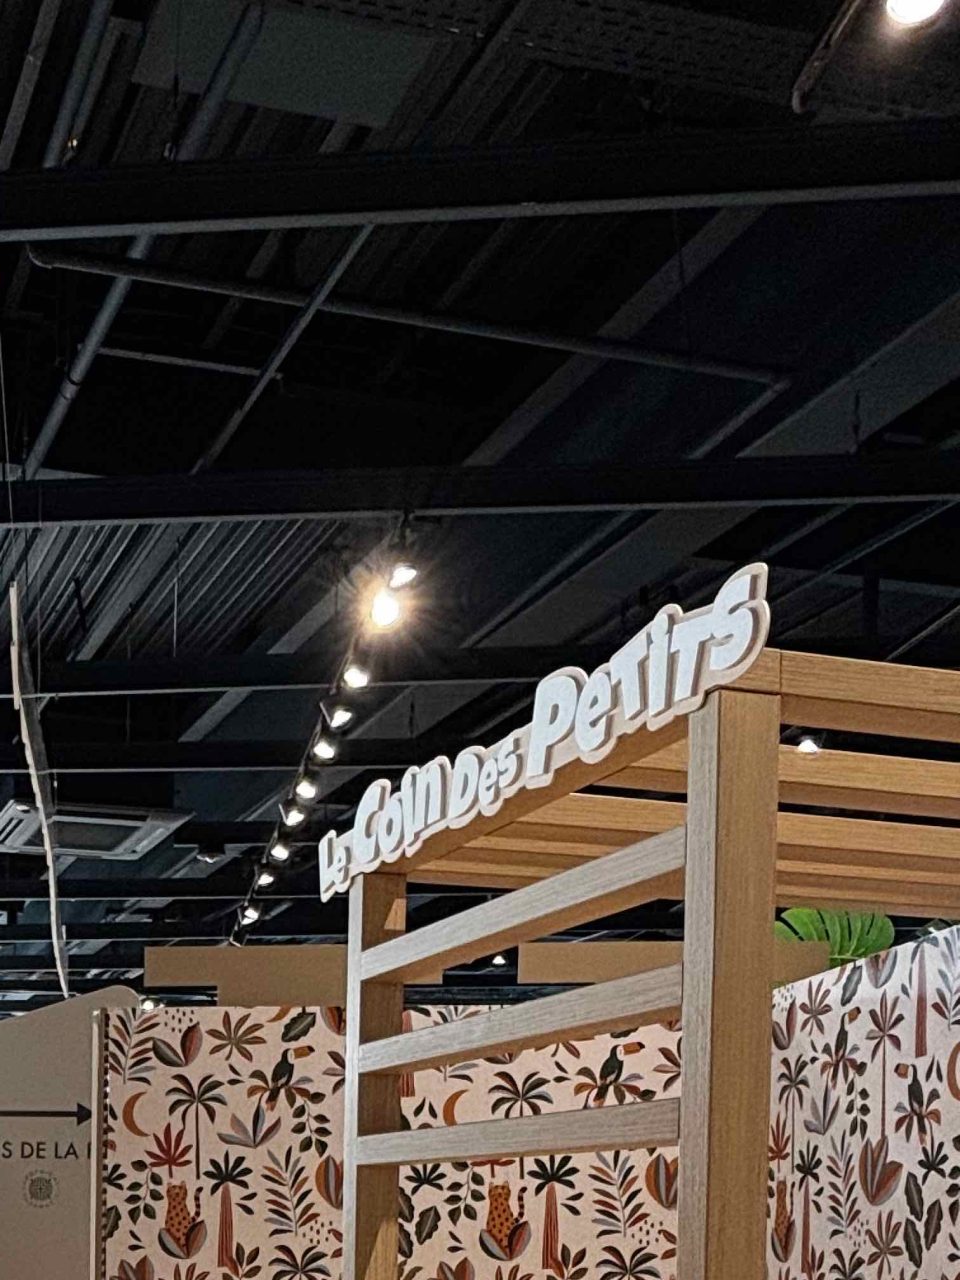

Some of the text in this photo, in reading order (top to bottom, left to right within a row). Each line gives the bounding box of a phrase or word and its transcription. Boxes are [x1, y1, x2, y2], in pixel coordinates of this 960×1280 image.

[319, 832, 350, 899] Le
[449, 738, 523, 822] Des
[20, 1141, 47, 1159] DE
[54, 1141, 79, 1160] LA
